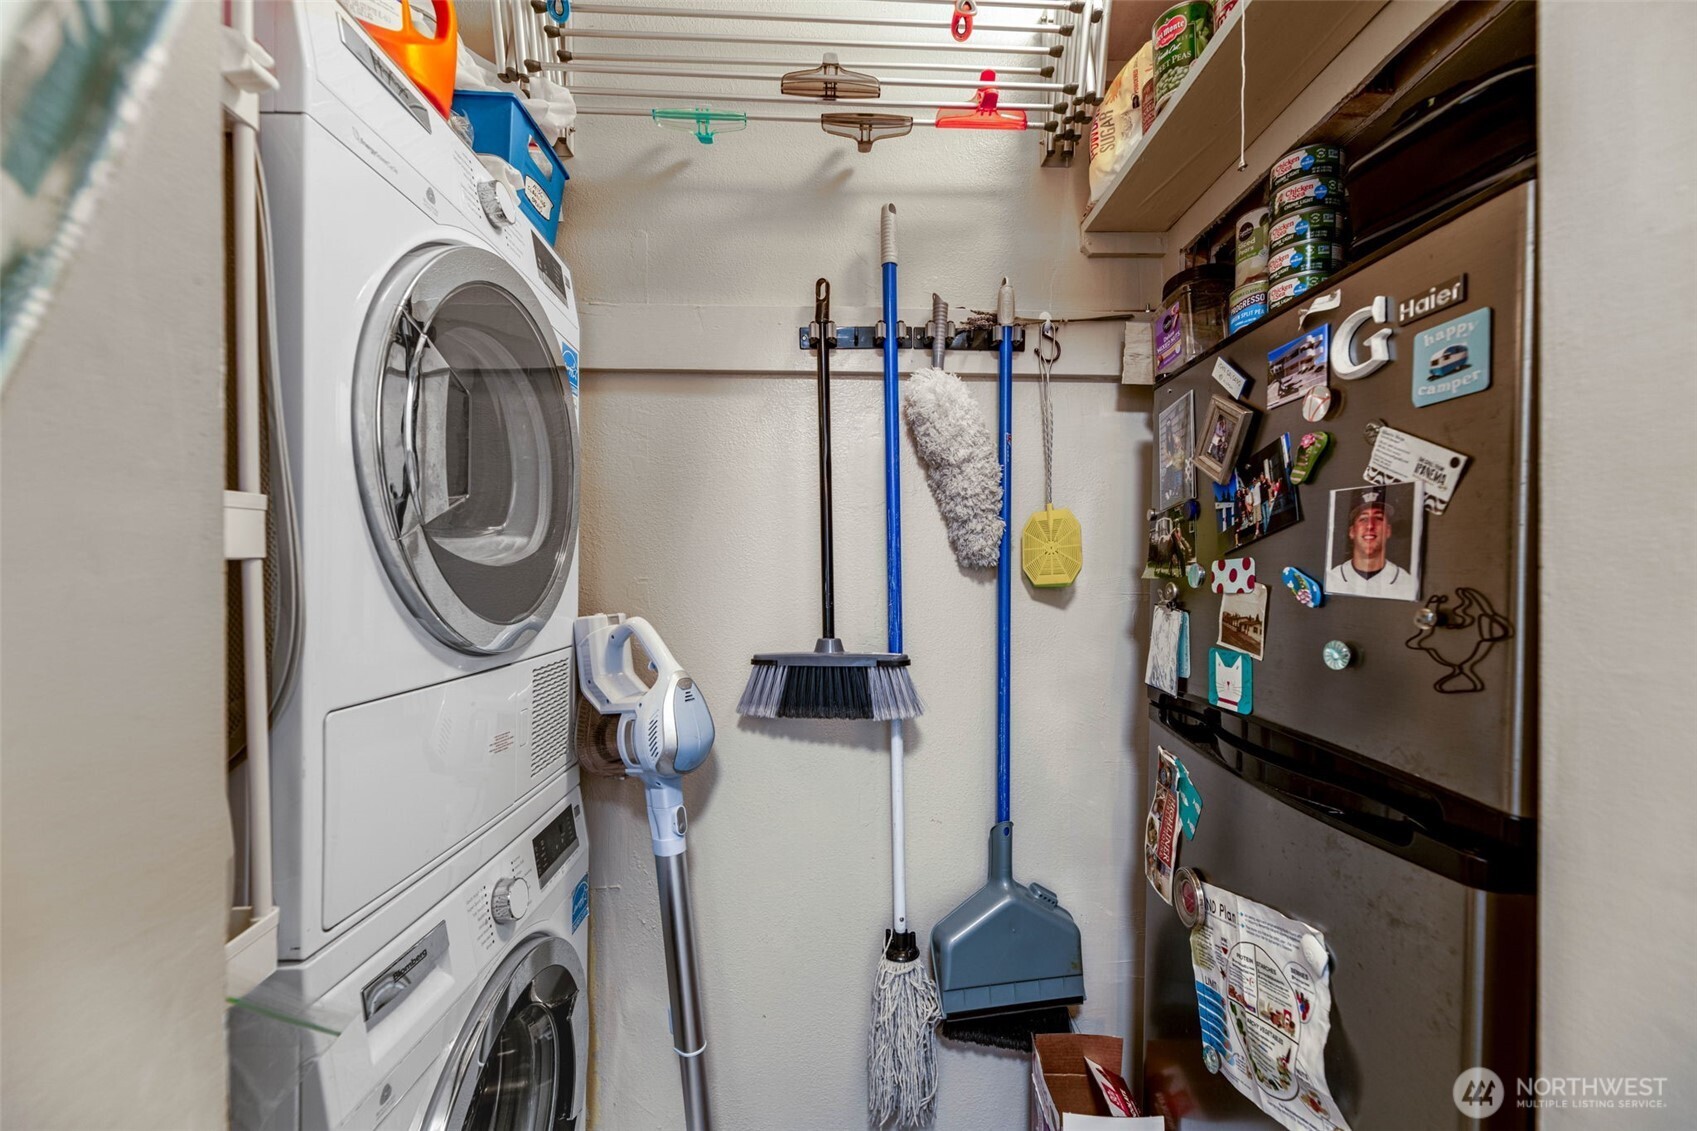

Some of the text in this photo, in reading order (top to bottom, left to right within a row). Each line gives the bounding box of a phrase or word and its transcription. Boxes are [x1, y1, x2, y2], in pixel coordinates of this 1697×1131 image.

[1164, 20, 1185, 35] Monte
[1172, 51, 1192, 64] PEAS
[1100, 109, 1115, 154] SUGAR
[1275, 156, 1300, 172] Chicken
[1285, 184, 1314, 197] Chicken
[1231, 293, 1266, 315] PROGRESSO
[1400, 282, 1461, 322] Haier
[1241, 309, 1254, 319] SPLIT
[1254, 308, 1265, 316] PEA
[1330, 295, 1393, 380] G
[1423, 320, 1478, 346] happy
[1417, 370, 1481, 396] camper
[1219, 904, 1236, 923] Plan
[393, 949, 427, 982] Blomberg
